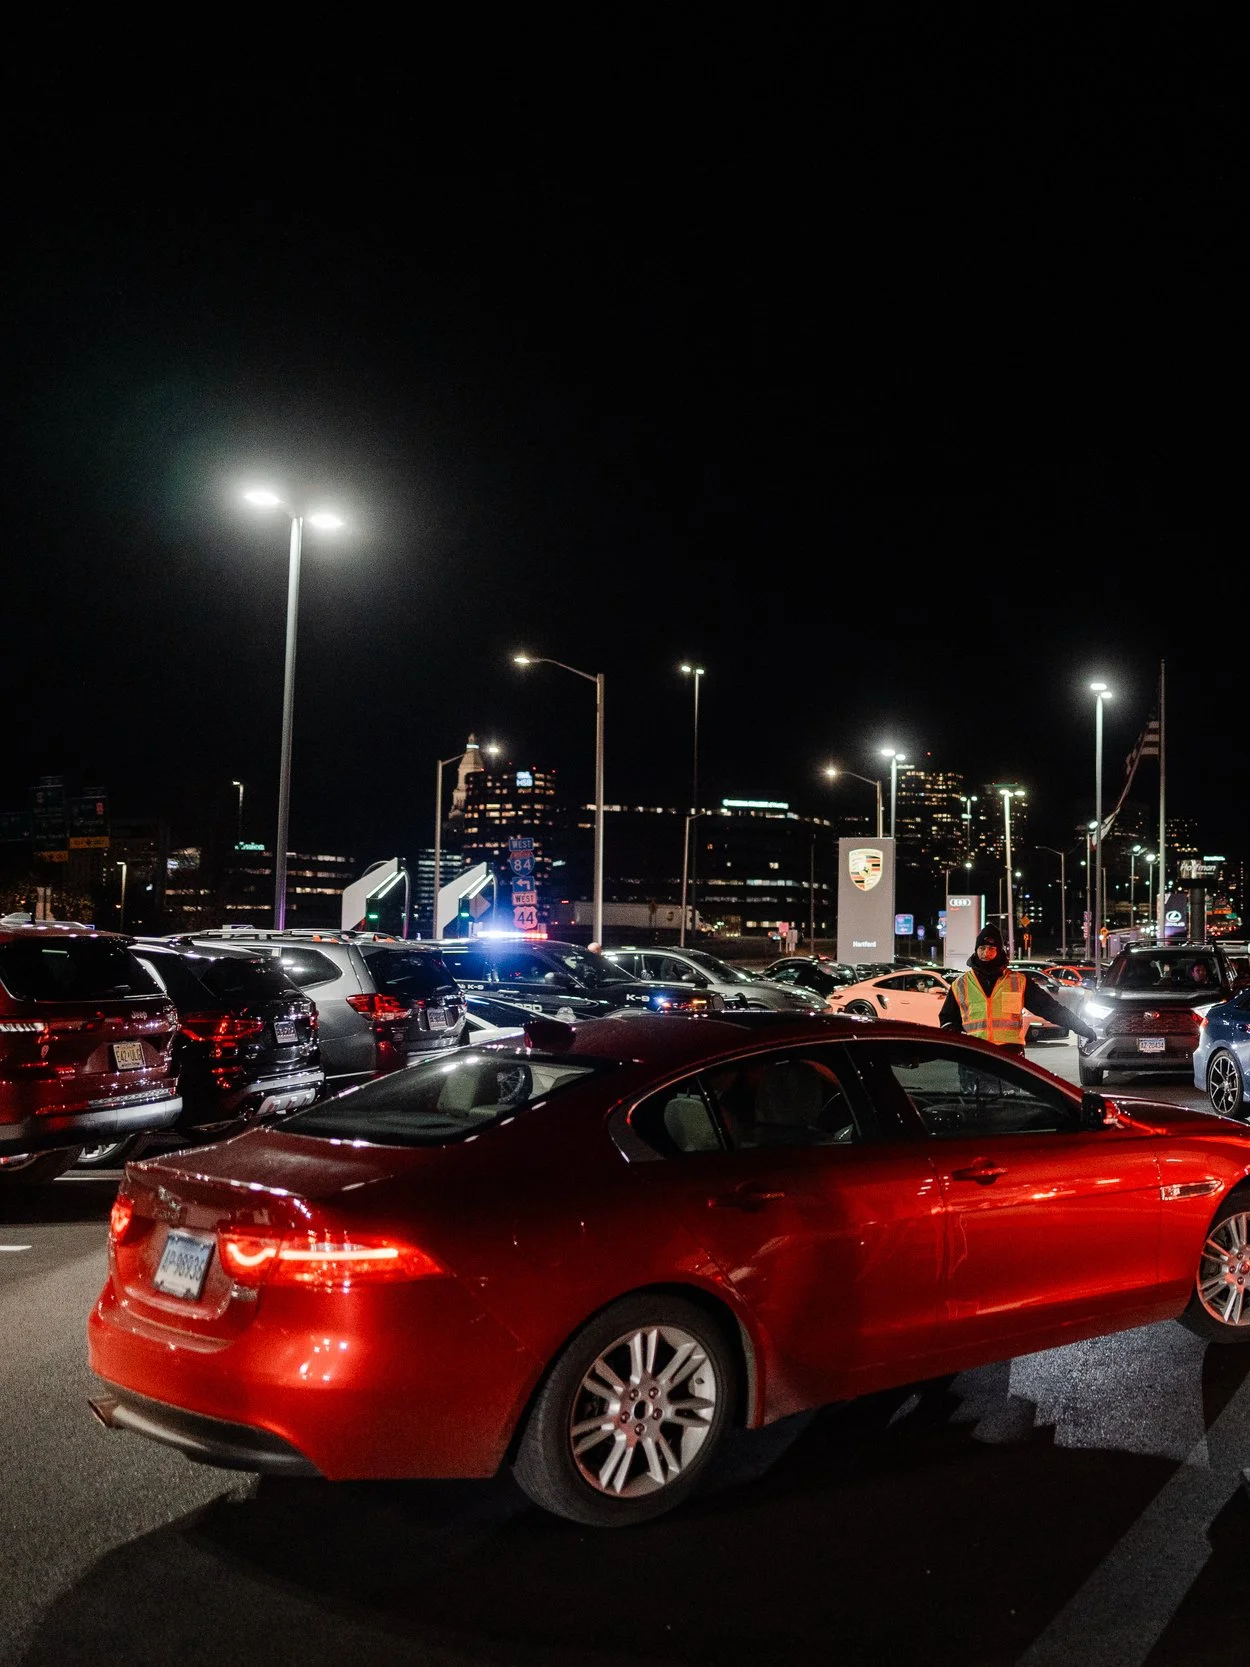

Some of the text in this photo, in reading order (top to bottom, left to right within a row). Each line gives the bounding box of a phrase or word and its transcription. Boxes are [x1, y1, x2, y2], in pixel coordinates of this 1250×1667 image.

[512, 841, 531, 849] WEST
[514, 860, 531, 871] 84
[515, 895, 534, 903] WEST
[518, 912, 533, 925] 44
[626, 994, 650, 1002] K-9
[132, 1011, 148, 1020] Jeep
